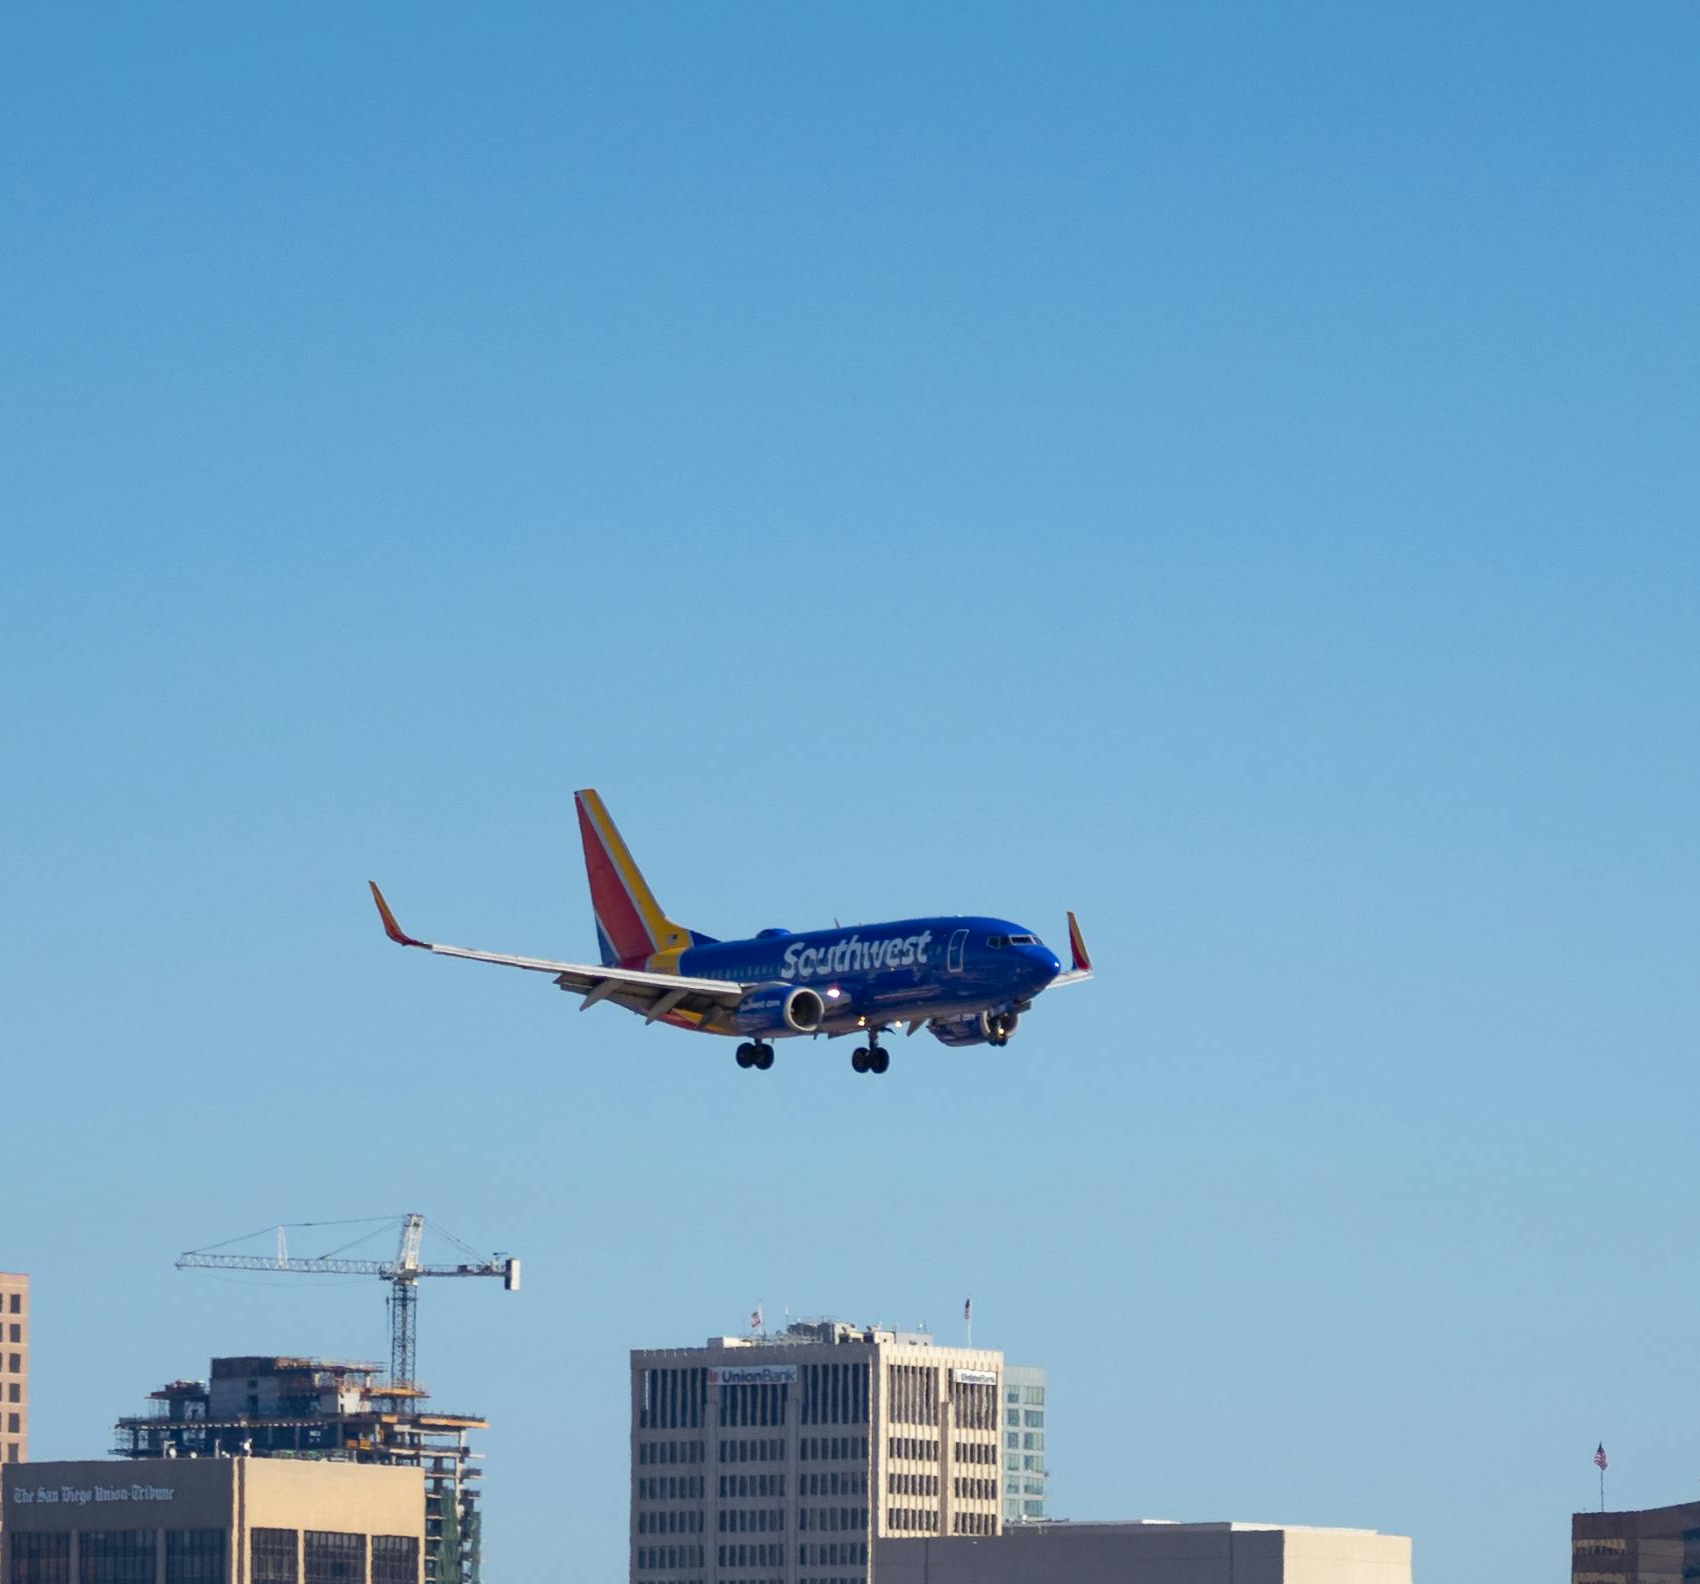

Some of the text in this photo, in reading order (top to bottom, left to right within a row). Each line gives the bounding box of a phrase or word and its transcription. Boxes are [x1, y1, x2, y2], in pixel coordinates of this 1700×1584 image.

[780, 929, 932, 979] Southwest
[722, 1368, 796, 1383] UnionBank
[13, 1484, 175, 1505] The San Diego Union-Tribune
